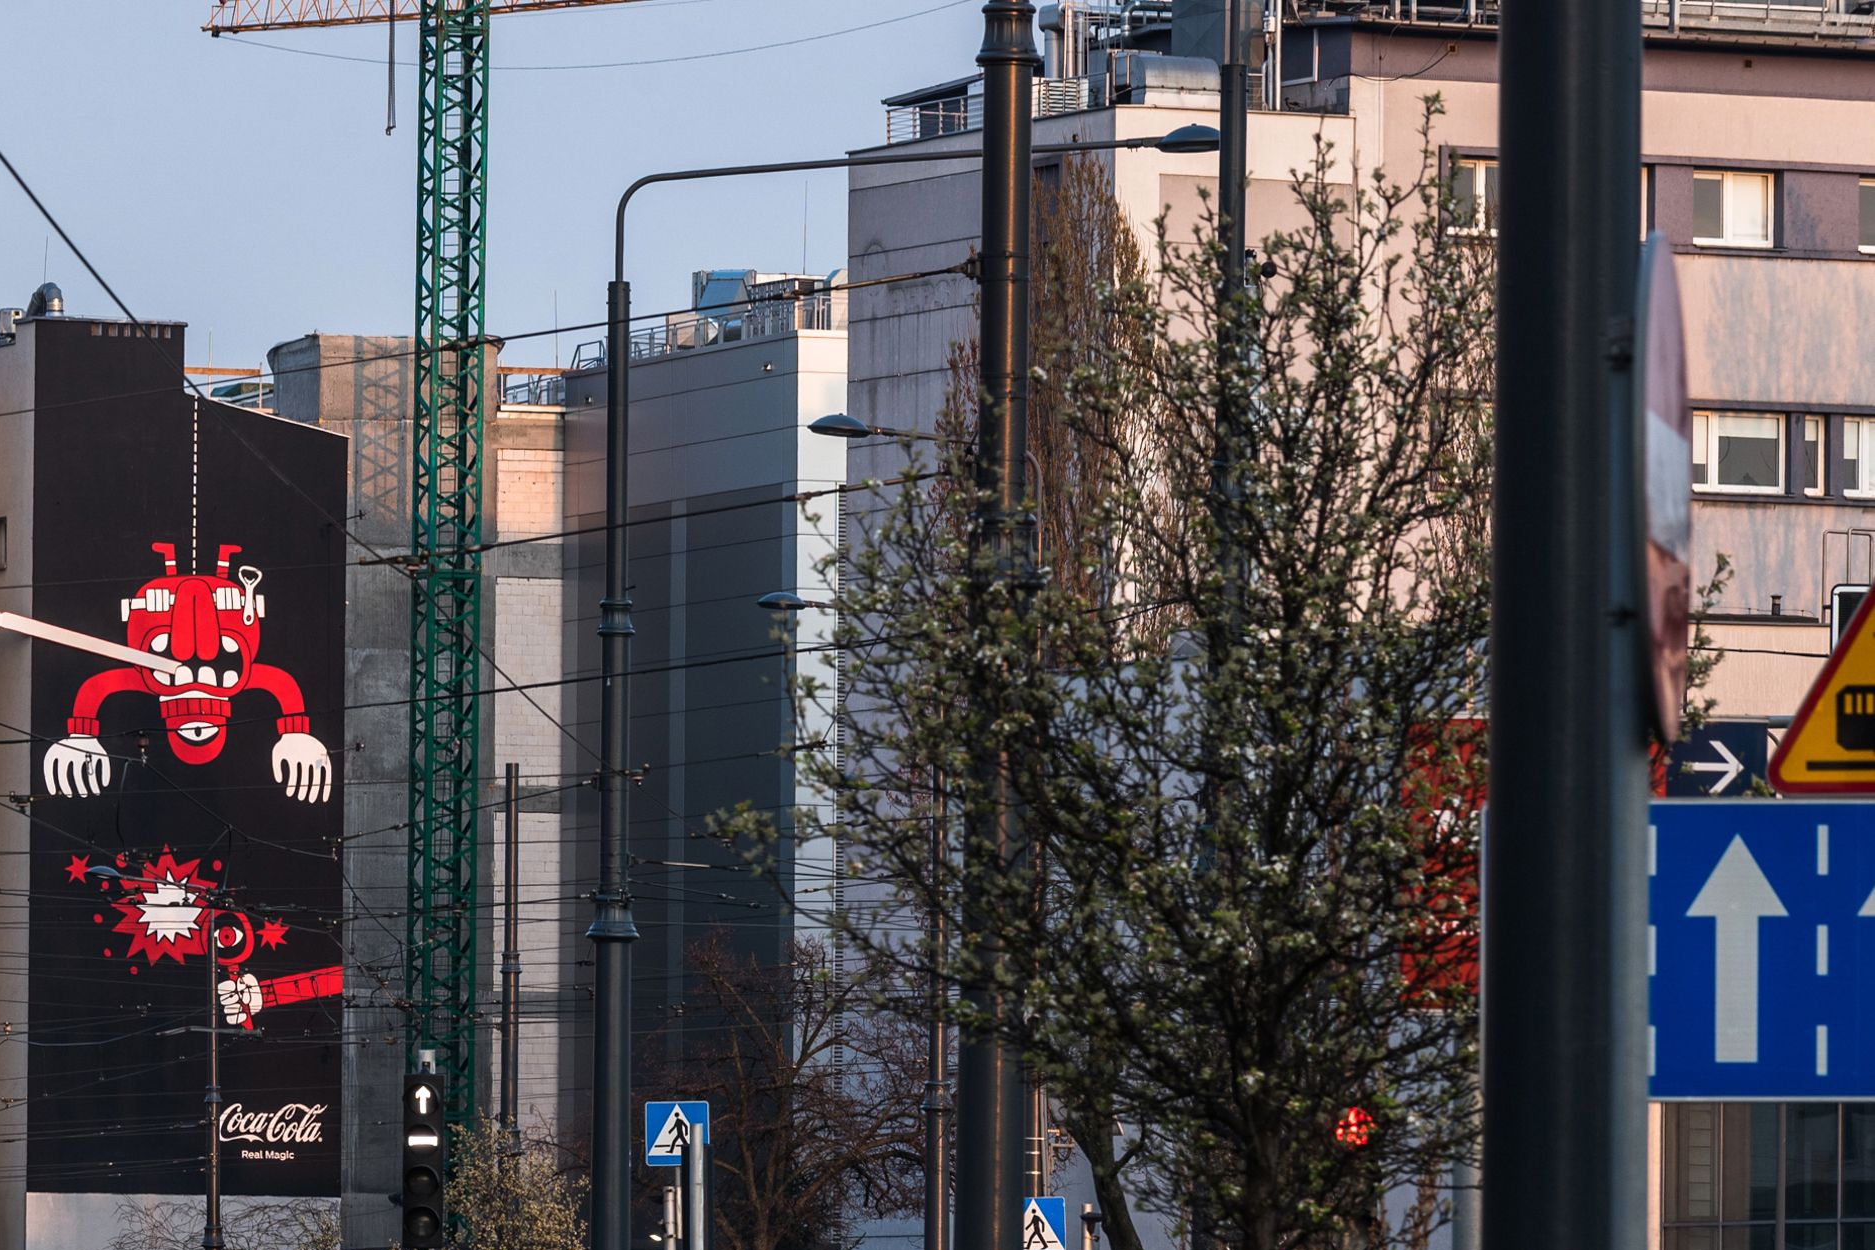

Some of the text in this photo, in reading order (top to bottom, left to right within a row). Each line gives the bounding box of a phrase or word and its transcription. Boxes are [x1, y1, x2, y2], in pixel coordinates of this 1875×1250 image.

[219, 1103, 328, 1143] Coca-Cola
[241, 1150, 295, 1161] Real Magic
